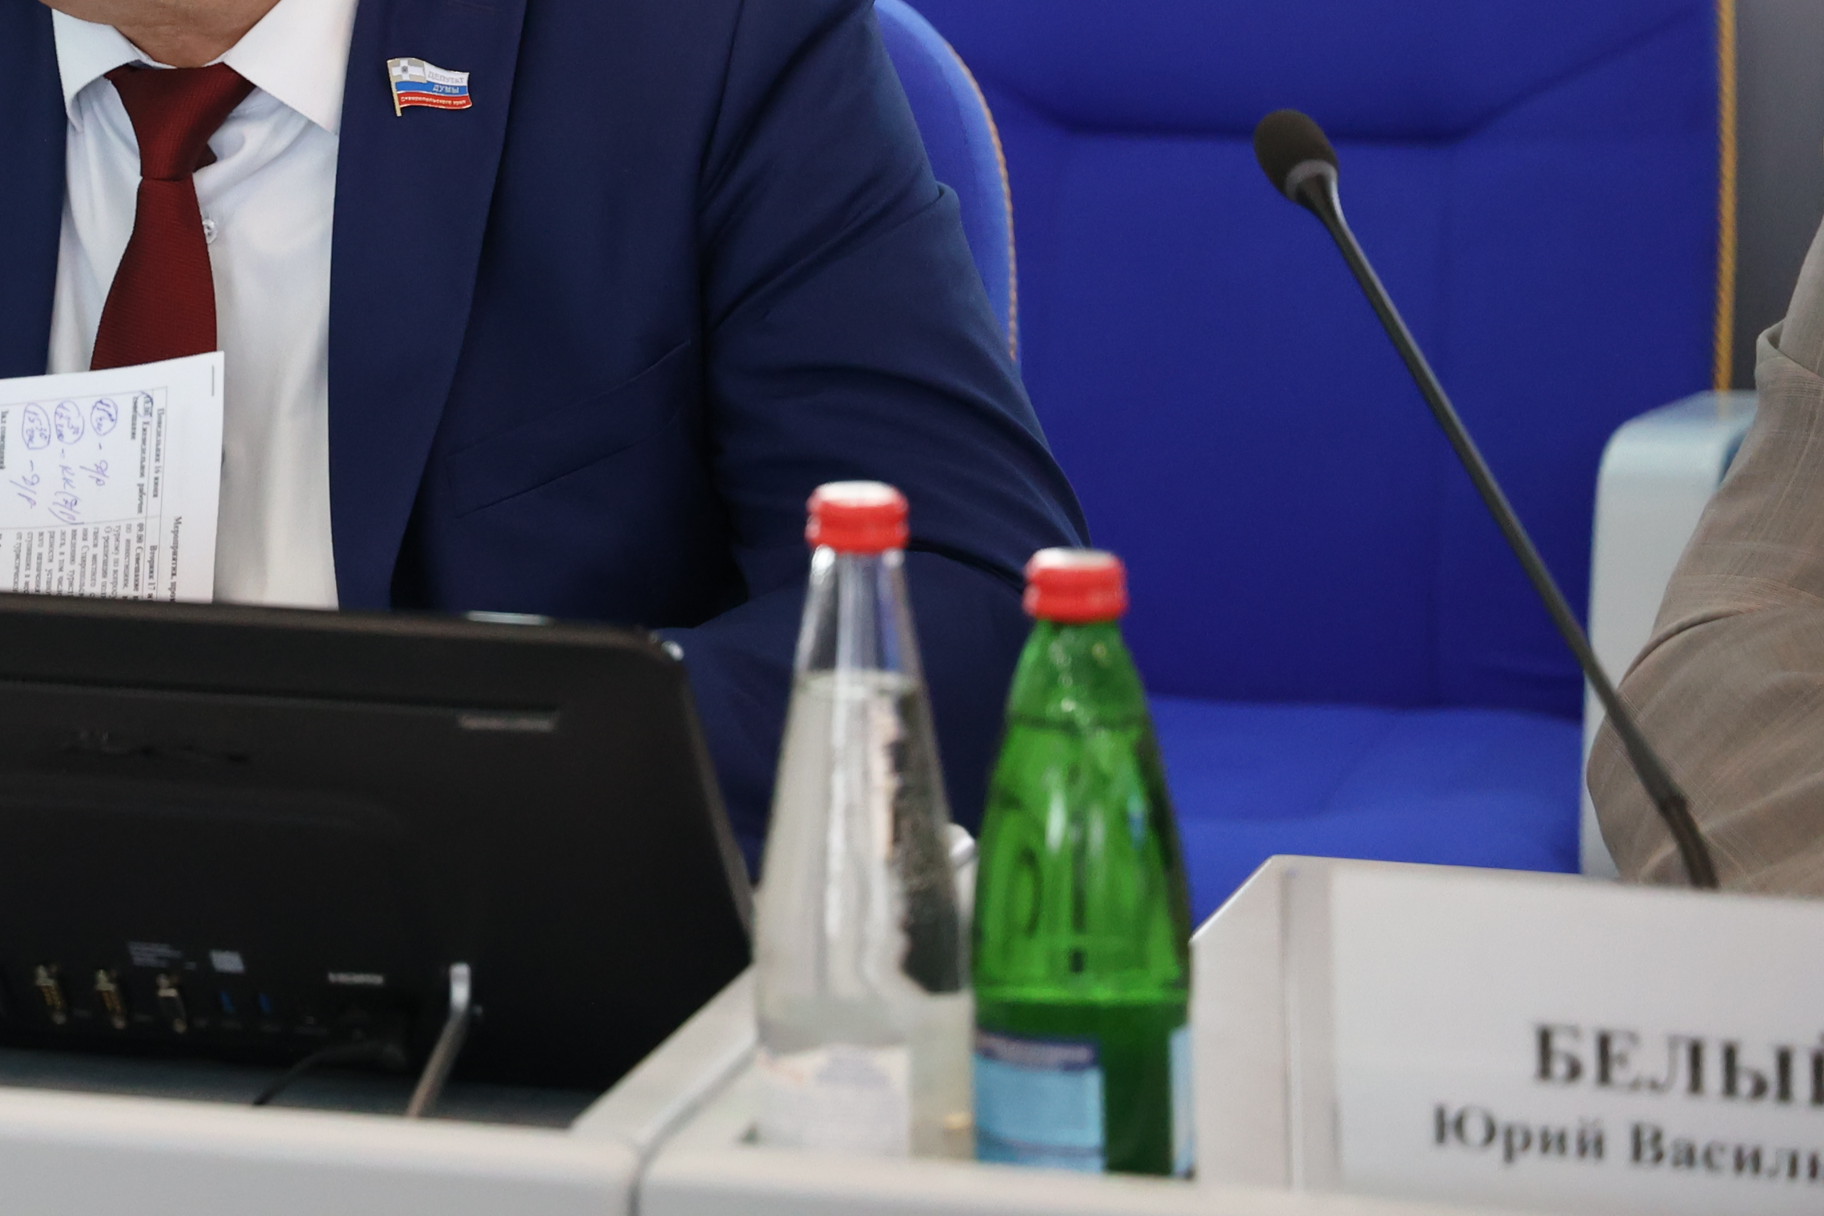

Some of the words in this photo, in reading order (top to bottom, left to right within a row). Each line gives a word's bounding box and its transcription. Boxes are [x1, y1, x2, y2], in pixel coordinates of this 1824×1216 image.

[427, 71, 465, 84] ДЕПУТАТ
[432, 84, 460, 94] ДУМЫ
[148, 545, 158, 580] Вторник
[148, 582, 156, 590] 17
[1433, 1102, 1607, 1167] Юрий
